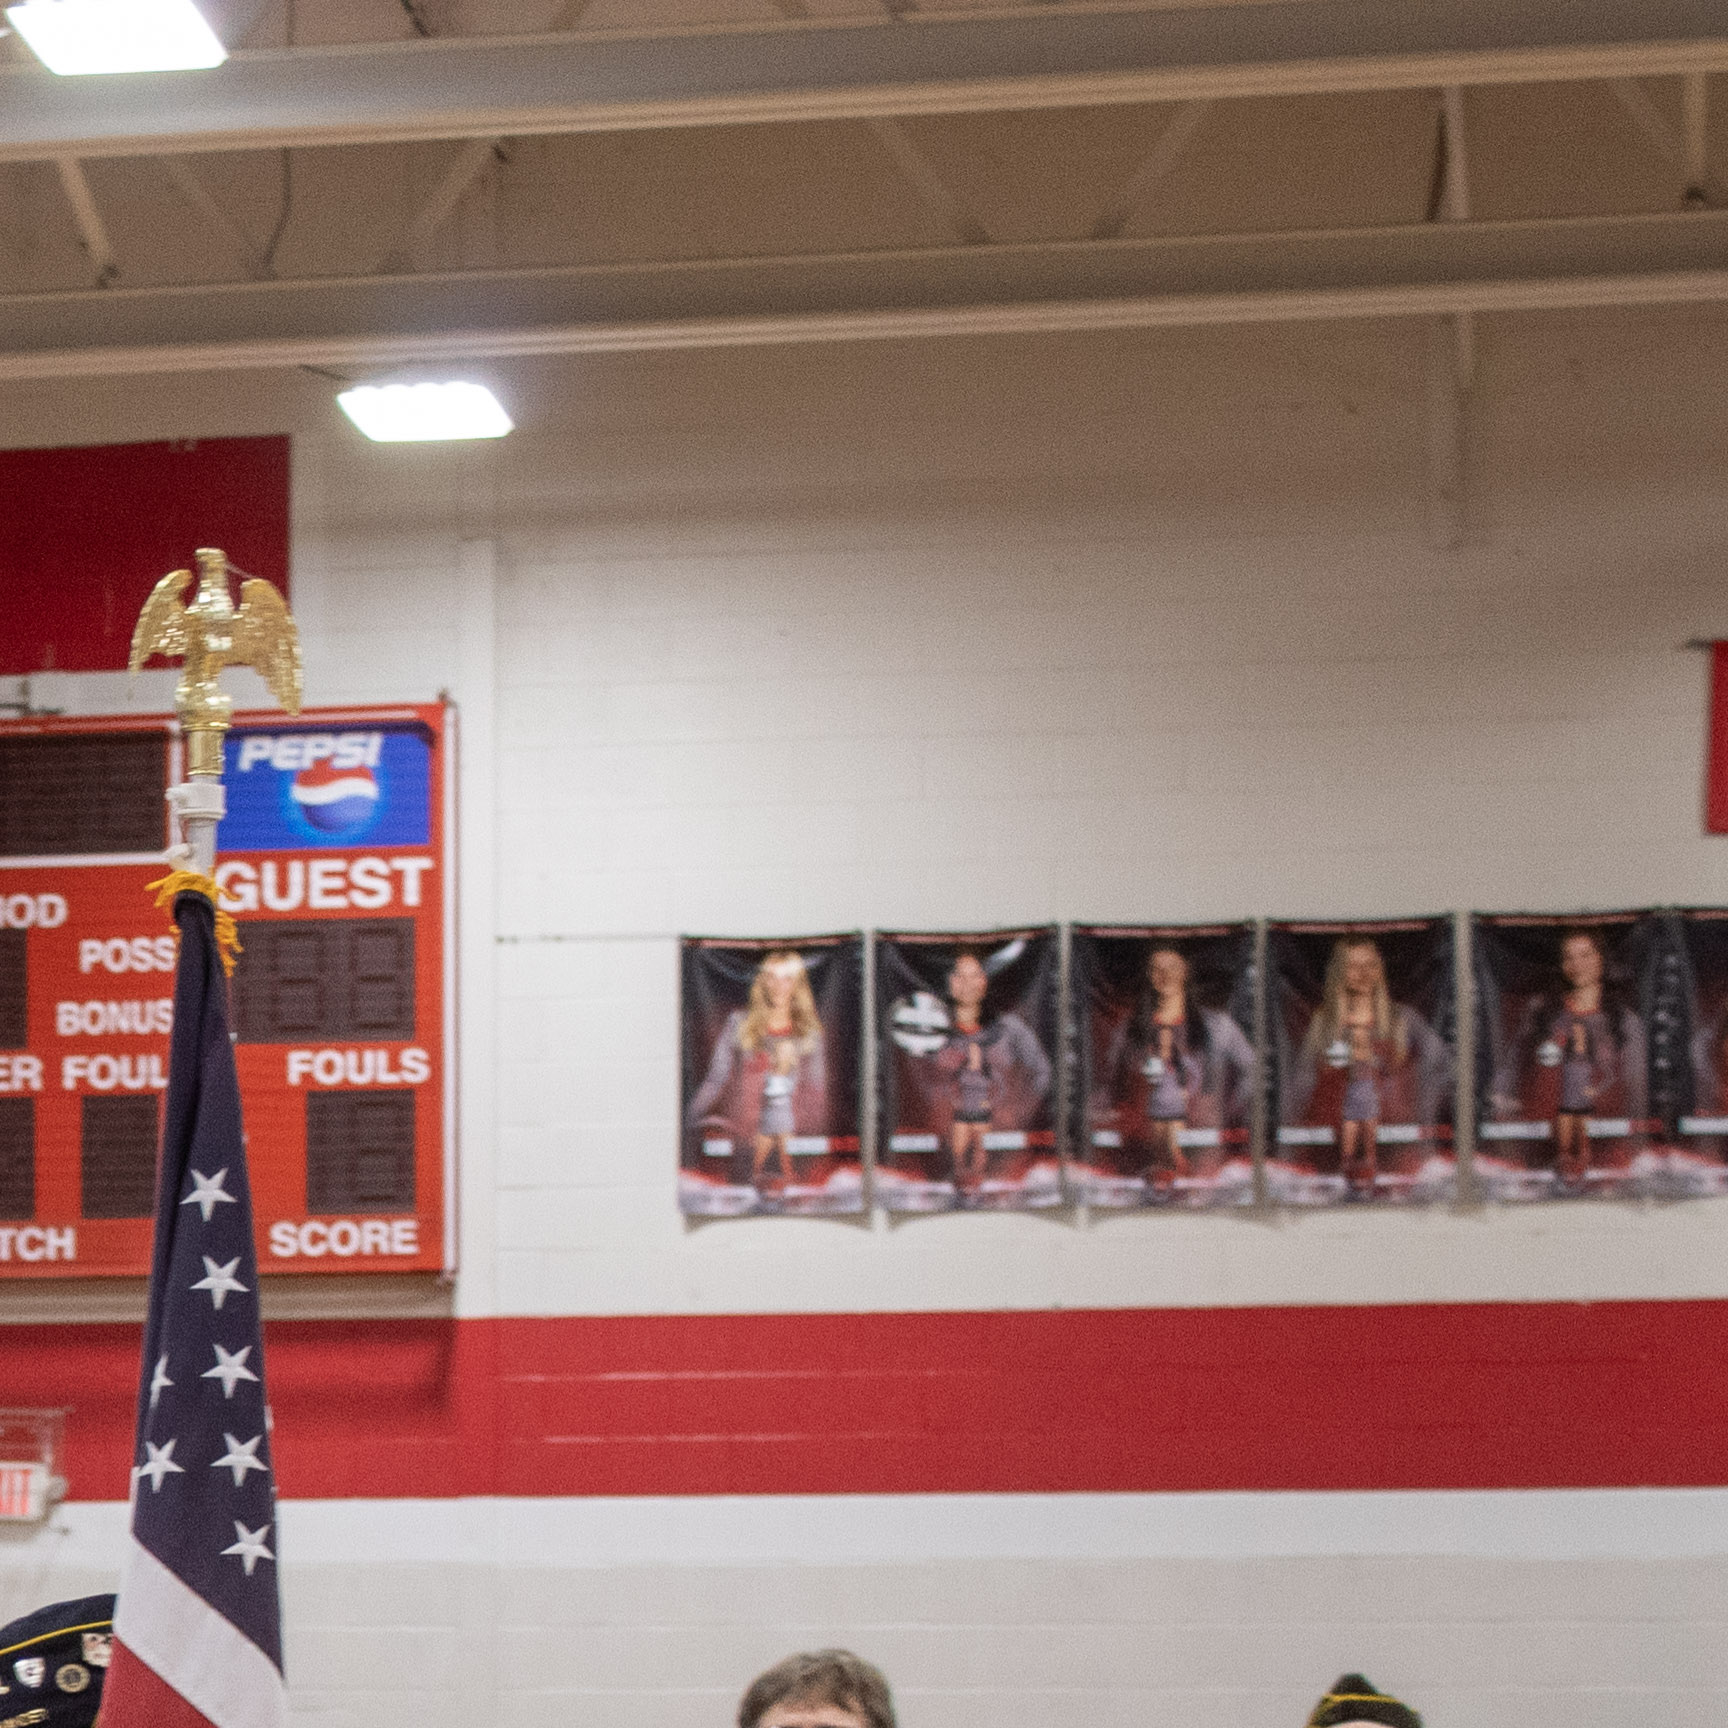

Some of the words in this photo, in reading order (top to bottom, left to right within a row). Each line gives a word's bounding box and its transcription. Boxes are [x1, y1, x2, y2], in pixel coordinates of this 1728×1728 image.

[239, 733, 383, 771] PEPSI
[215, 857, 433, 911] GUEST
[79, 937, 175, 973] POSS
[56, 998, 174, 1036] BONUS
[287, 1047, 430, 1085] FOULS
[270, 1219, 418, 1257] SCORE
